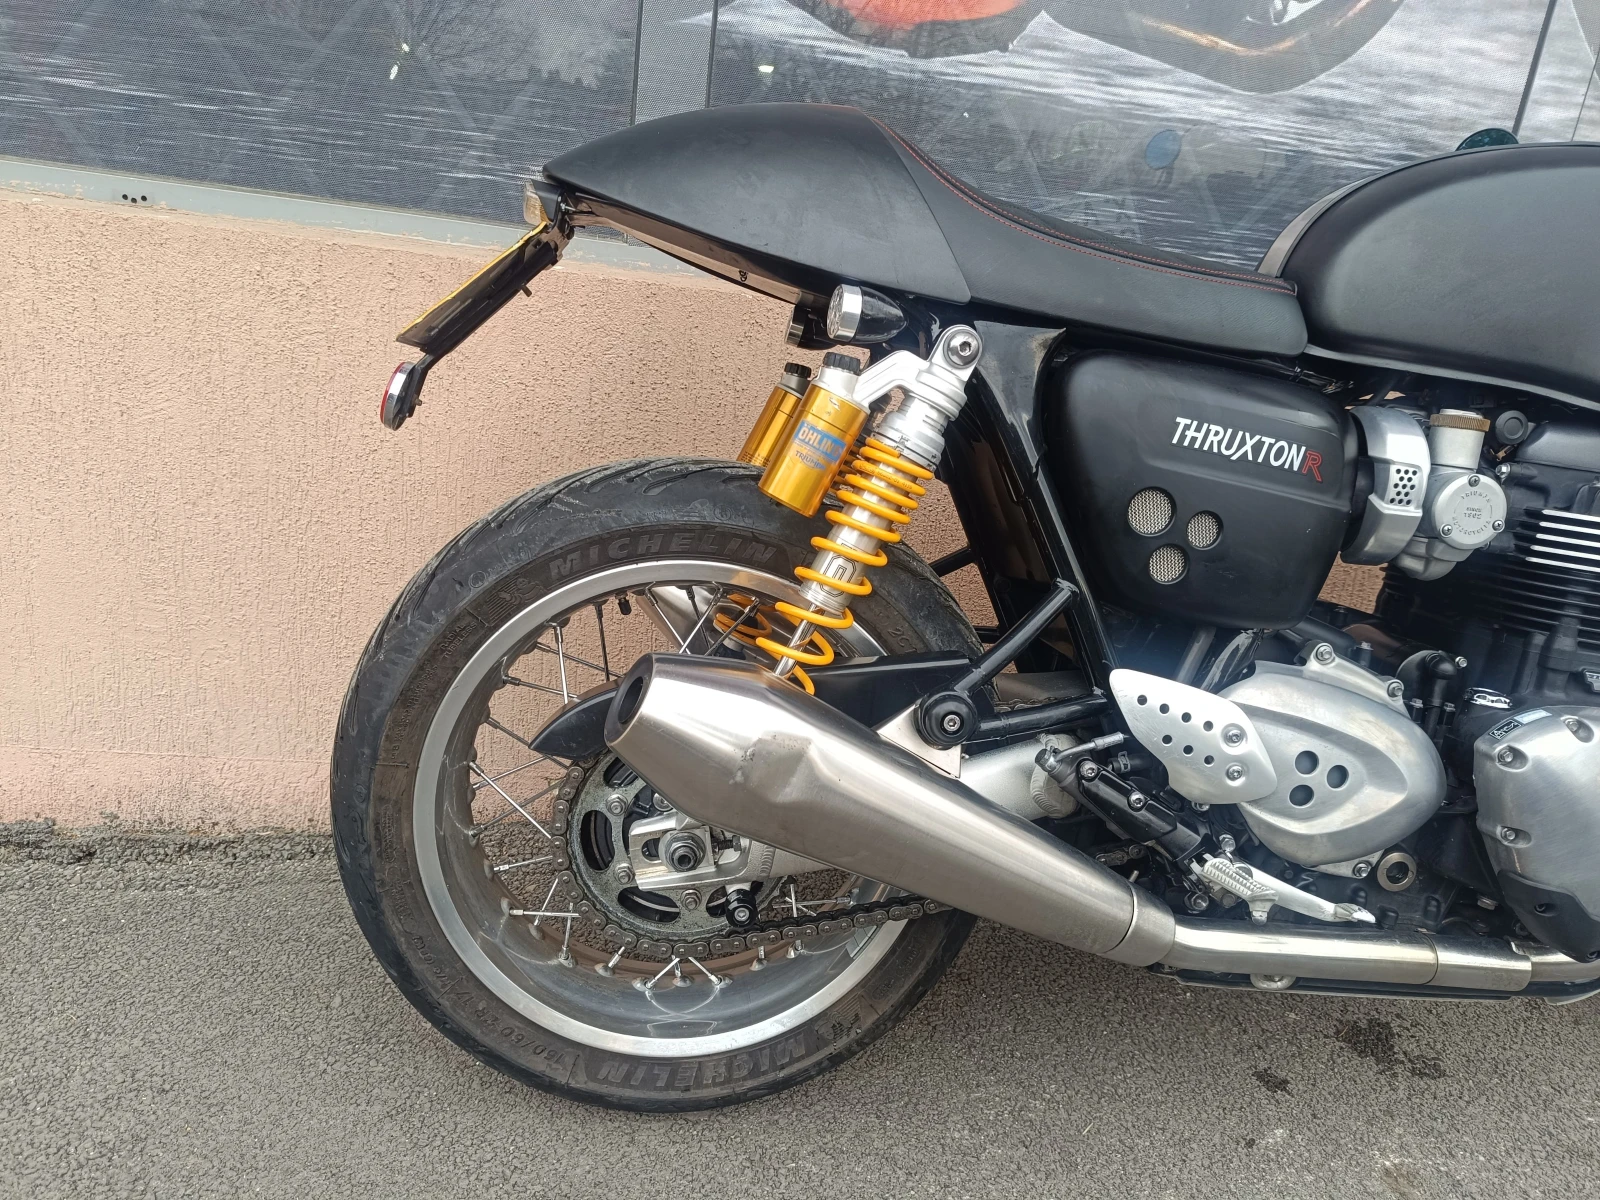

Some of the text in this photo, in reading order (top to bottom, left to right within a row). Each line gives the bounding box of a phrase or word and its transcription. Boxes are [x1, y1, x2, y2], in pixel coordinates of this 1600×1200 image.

[795, 450, 826, 469] TRIUMP
[548, 532, 777, 580] MICHELIN
[596, 1033, 806, 1088] MICHELIN
